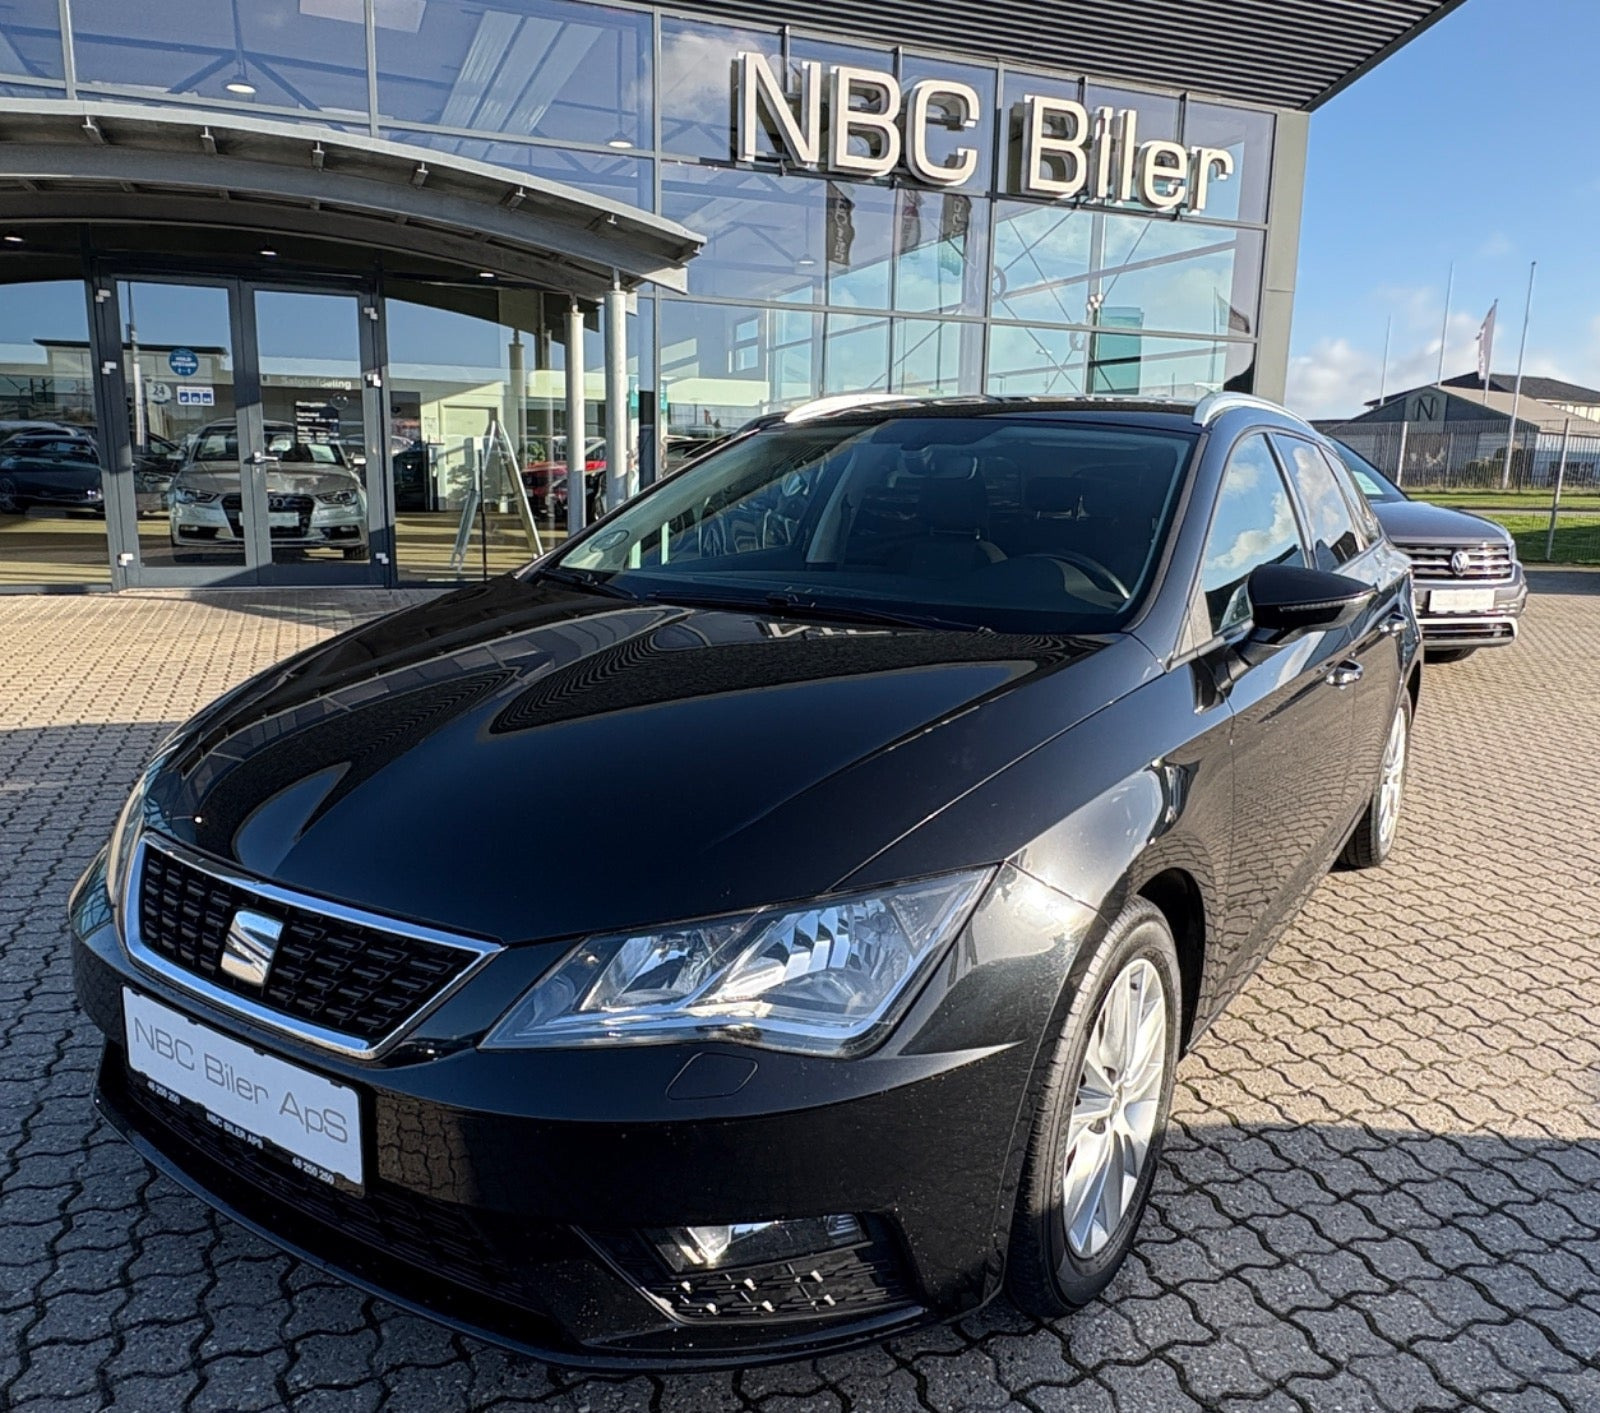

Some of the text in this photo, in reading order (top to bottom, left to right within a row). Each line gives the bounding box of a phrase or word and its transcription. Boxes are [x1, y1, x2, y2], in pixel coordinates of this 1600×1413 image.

[734, 51, 1235, 213] NBC Biler
[133, 1016, 348, 1143] NBC Biler ApS
